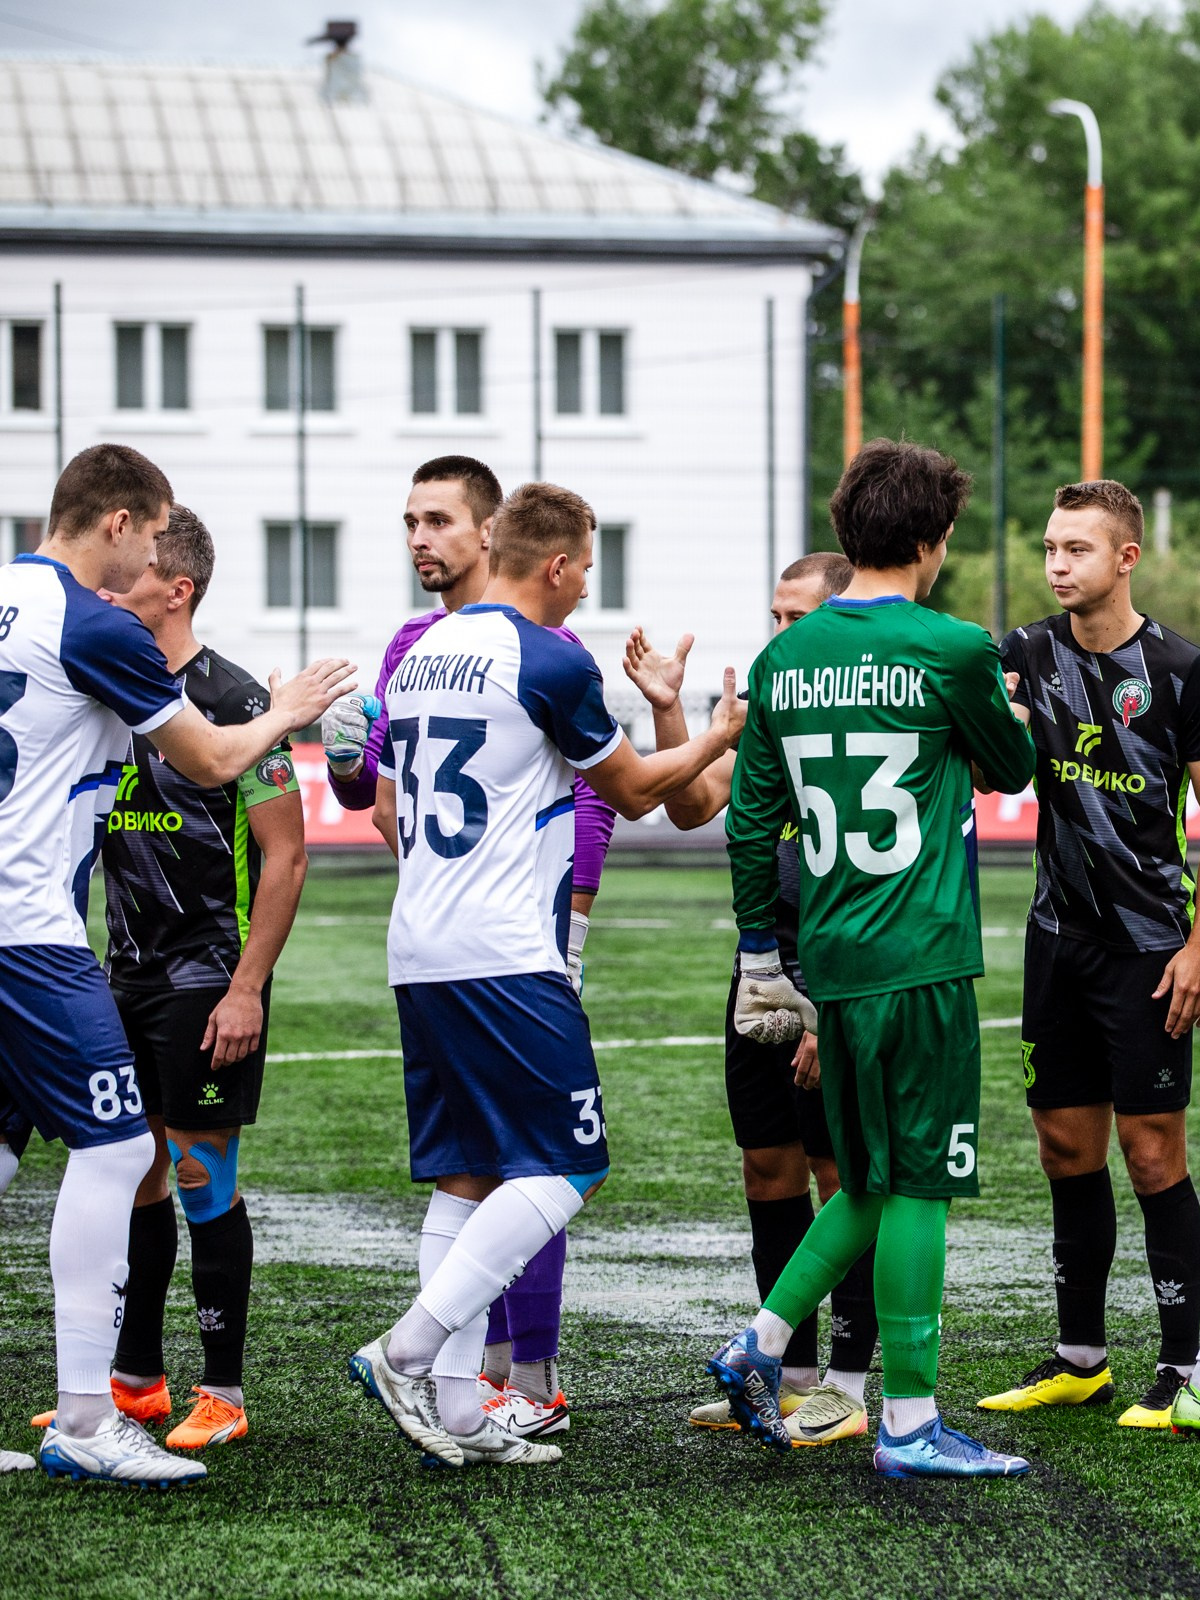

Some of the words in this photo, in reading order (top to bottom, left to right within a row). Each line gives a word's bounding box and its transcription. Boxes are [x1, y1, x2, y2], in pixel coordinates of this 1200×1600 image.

[0, 606, 19, 641] В
[389, 654, 494, 694] ПОЛЯКИН
[772, 653, 925, 711] ИЛЬЮШЁНОК
[390, 716, 488, 860] 33
[781, 732, 922, 878] 53
[88, 1065, 142, 1120] 83
[570, 1085, 607, 1145] 3
[947, 1123, 975, 1178] 5
